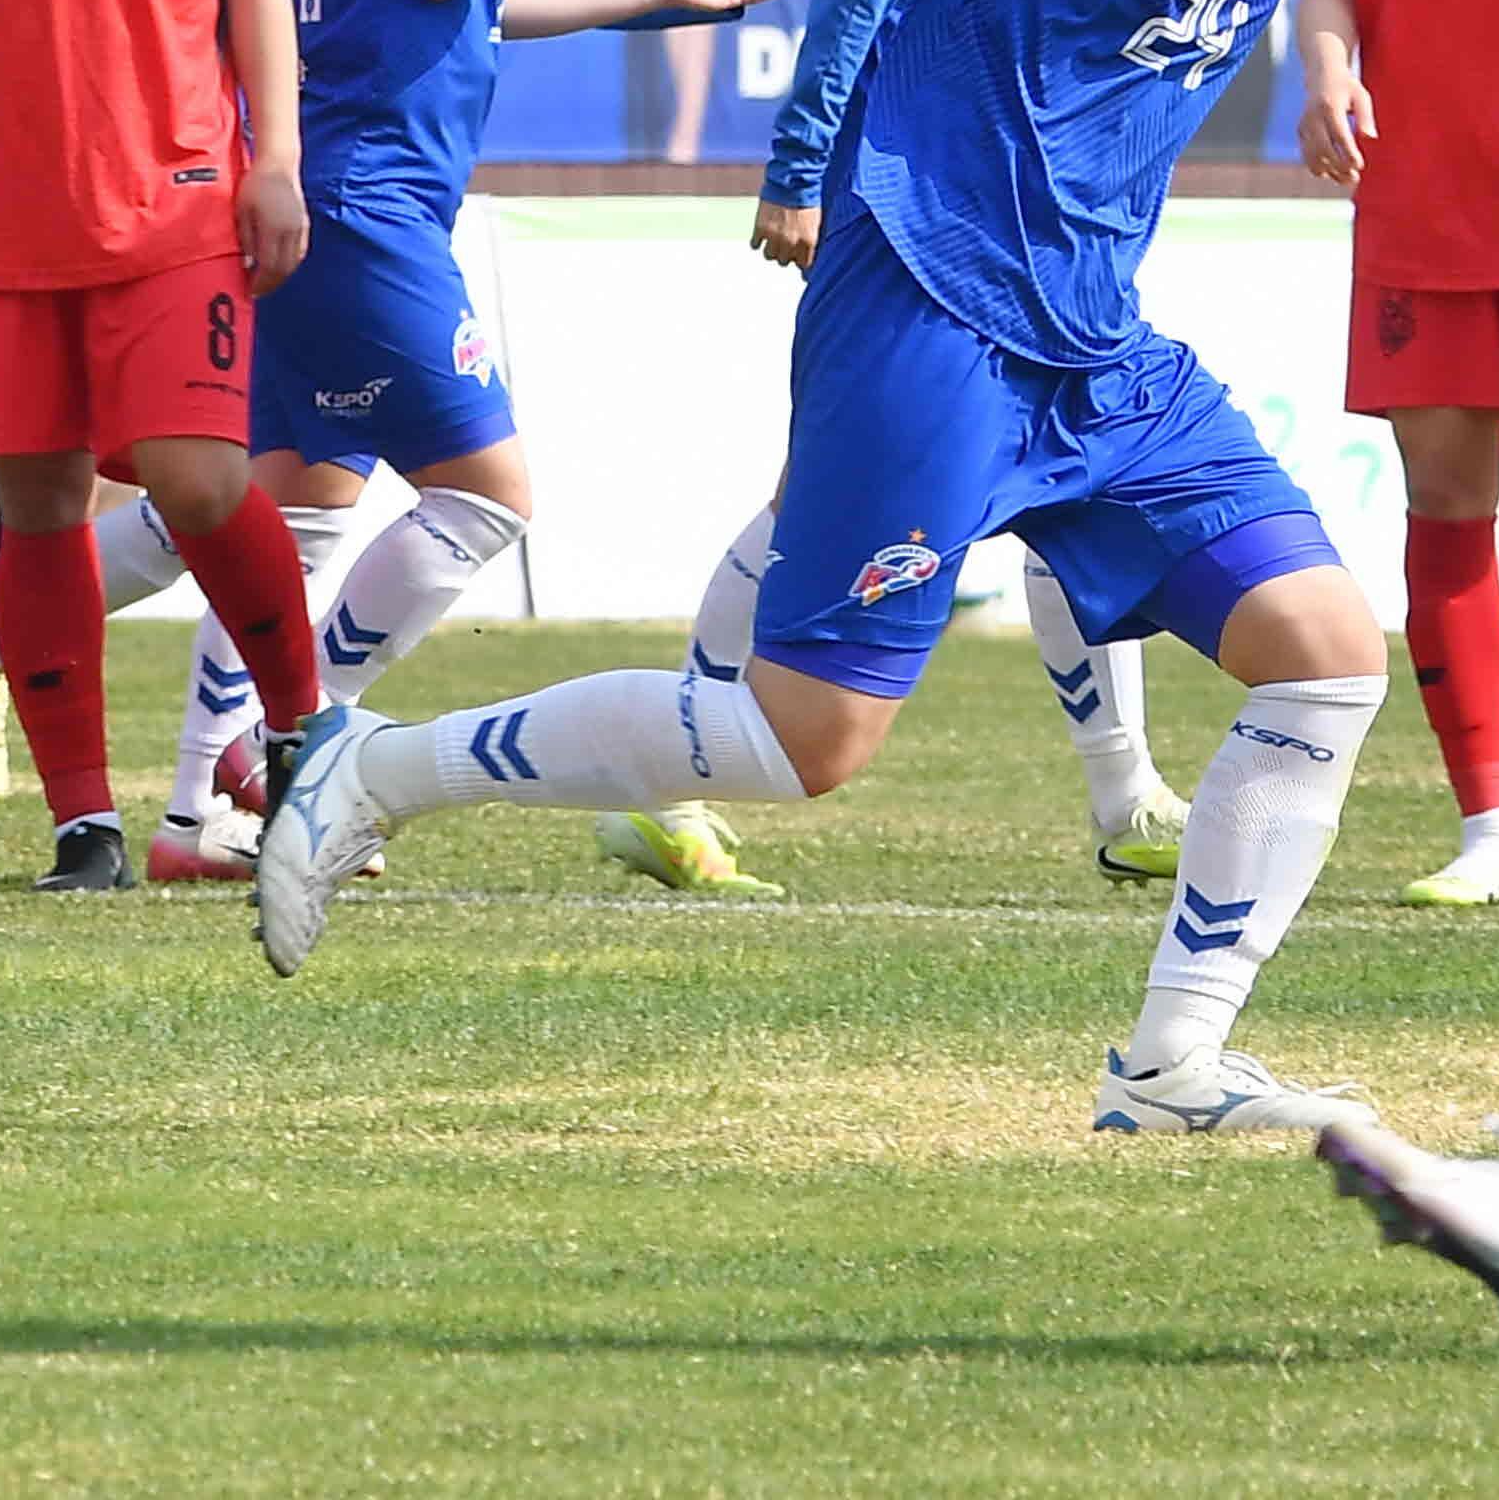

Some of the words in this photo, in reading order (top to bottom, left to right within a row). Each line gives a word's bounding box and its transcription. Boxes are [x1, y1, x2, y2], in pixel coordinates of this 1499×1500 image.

[208, 291, 236, 371] 8
[314, 389, 375, 409] KSPO
[1229, 718, 1335, 763] KSPO
